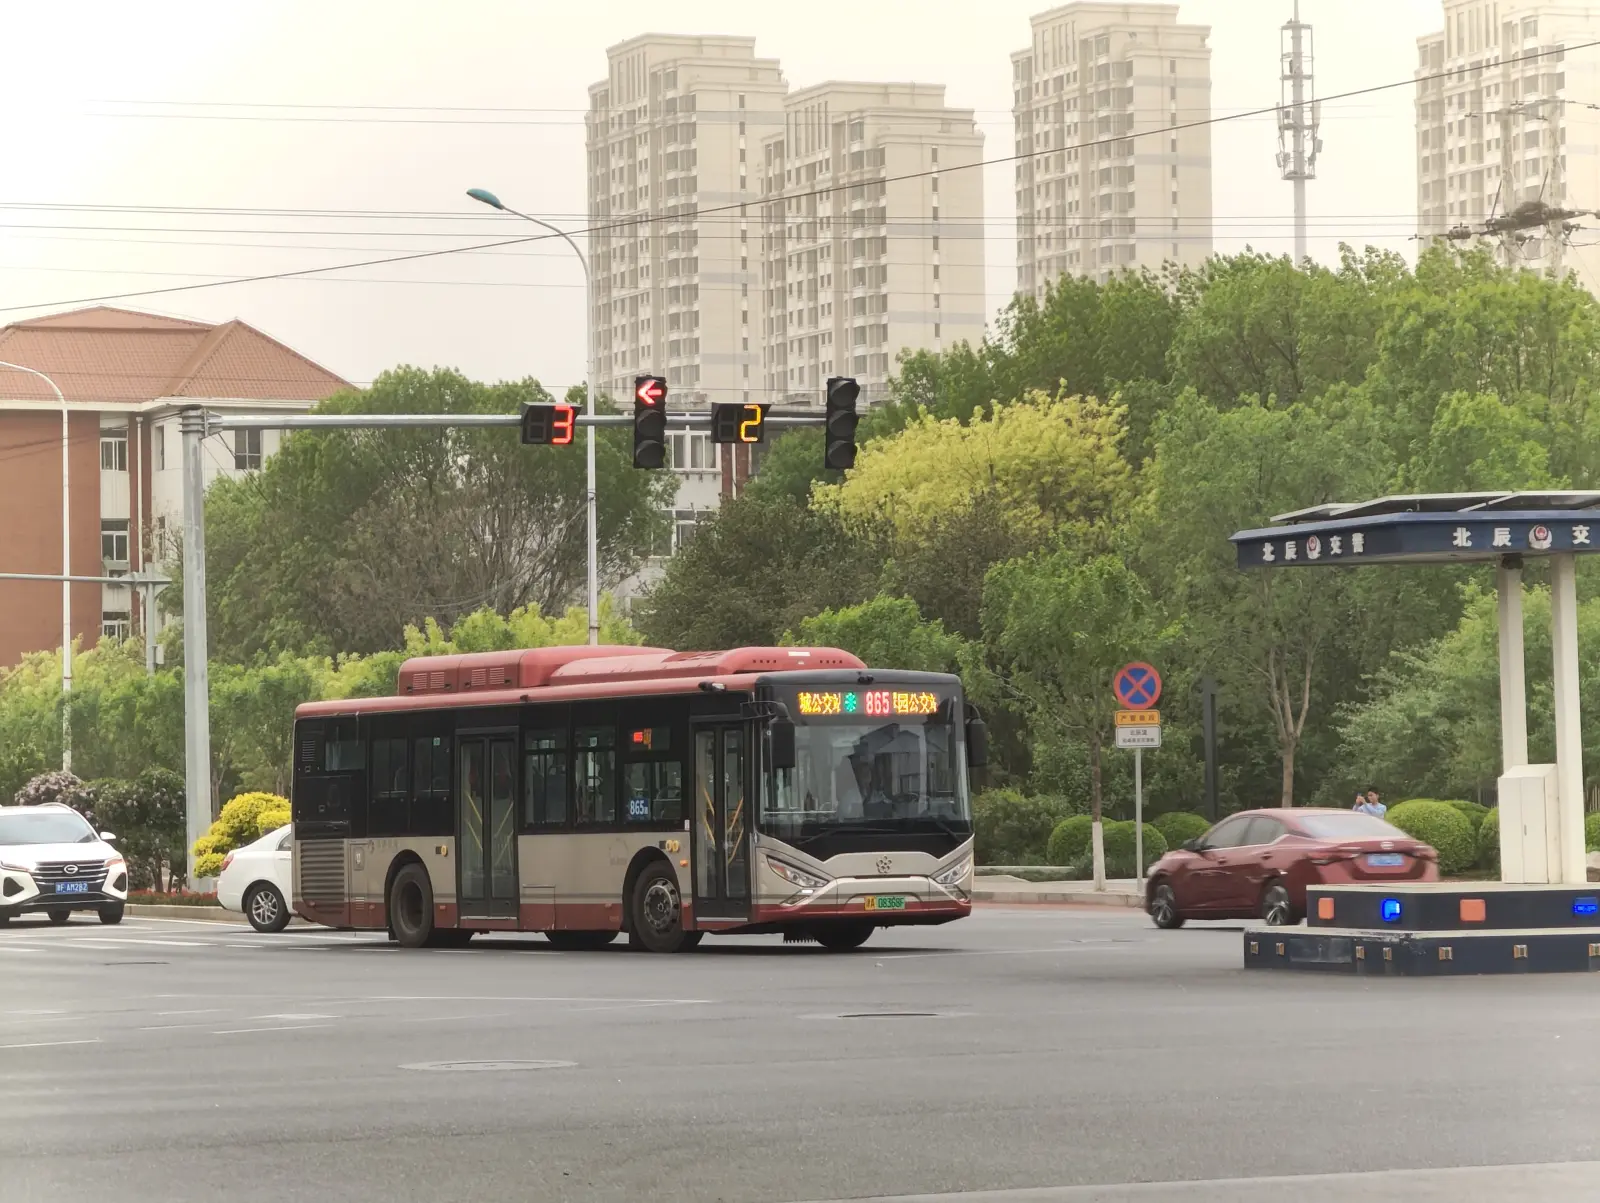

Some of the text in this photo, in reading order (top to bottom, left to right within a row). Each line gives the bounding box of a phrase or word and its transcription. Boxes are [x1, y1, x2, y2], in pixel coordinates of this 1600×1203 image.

[552, 404, 574, 445] 3
[740, 404, 762, 442] 2
[866, 692, 890, 715] 865
